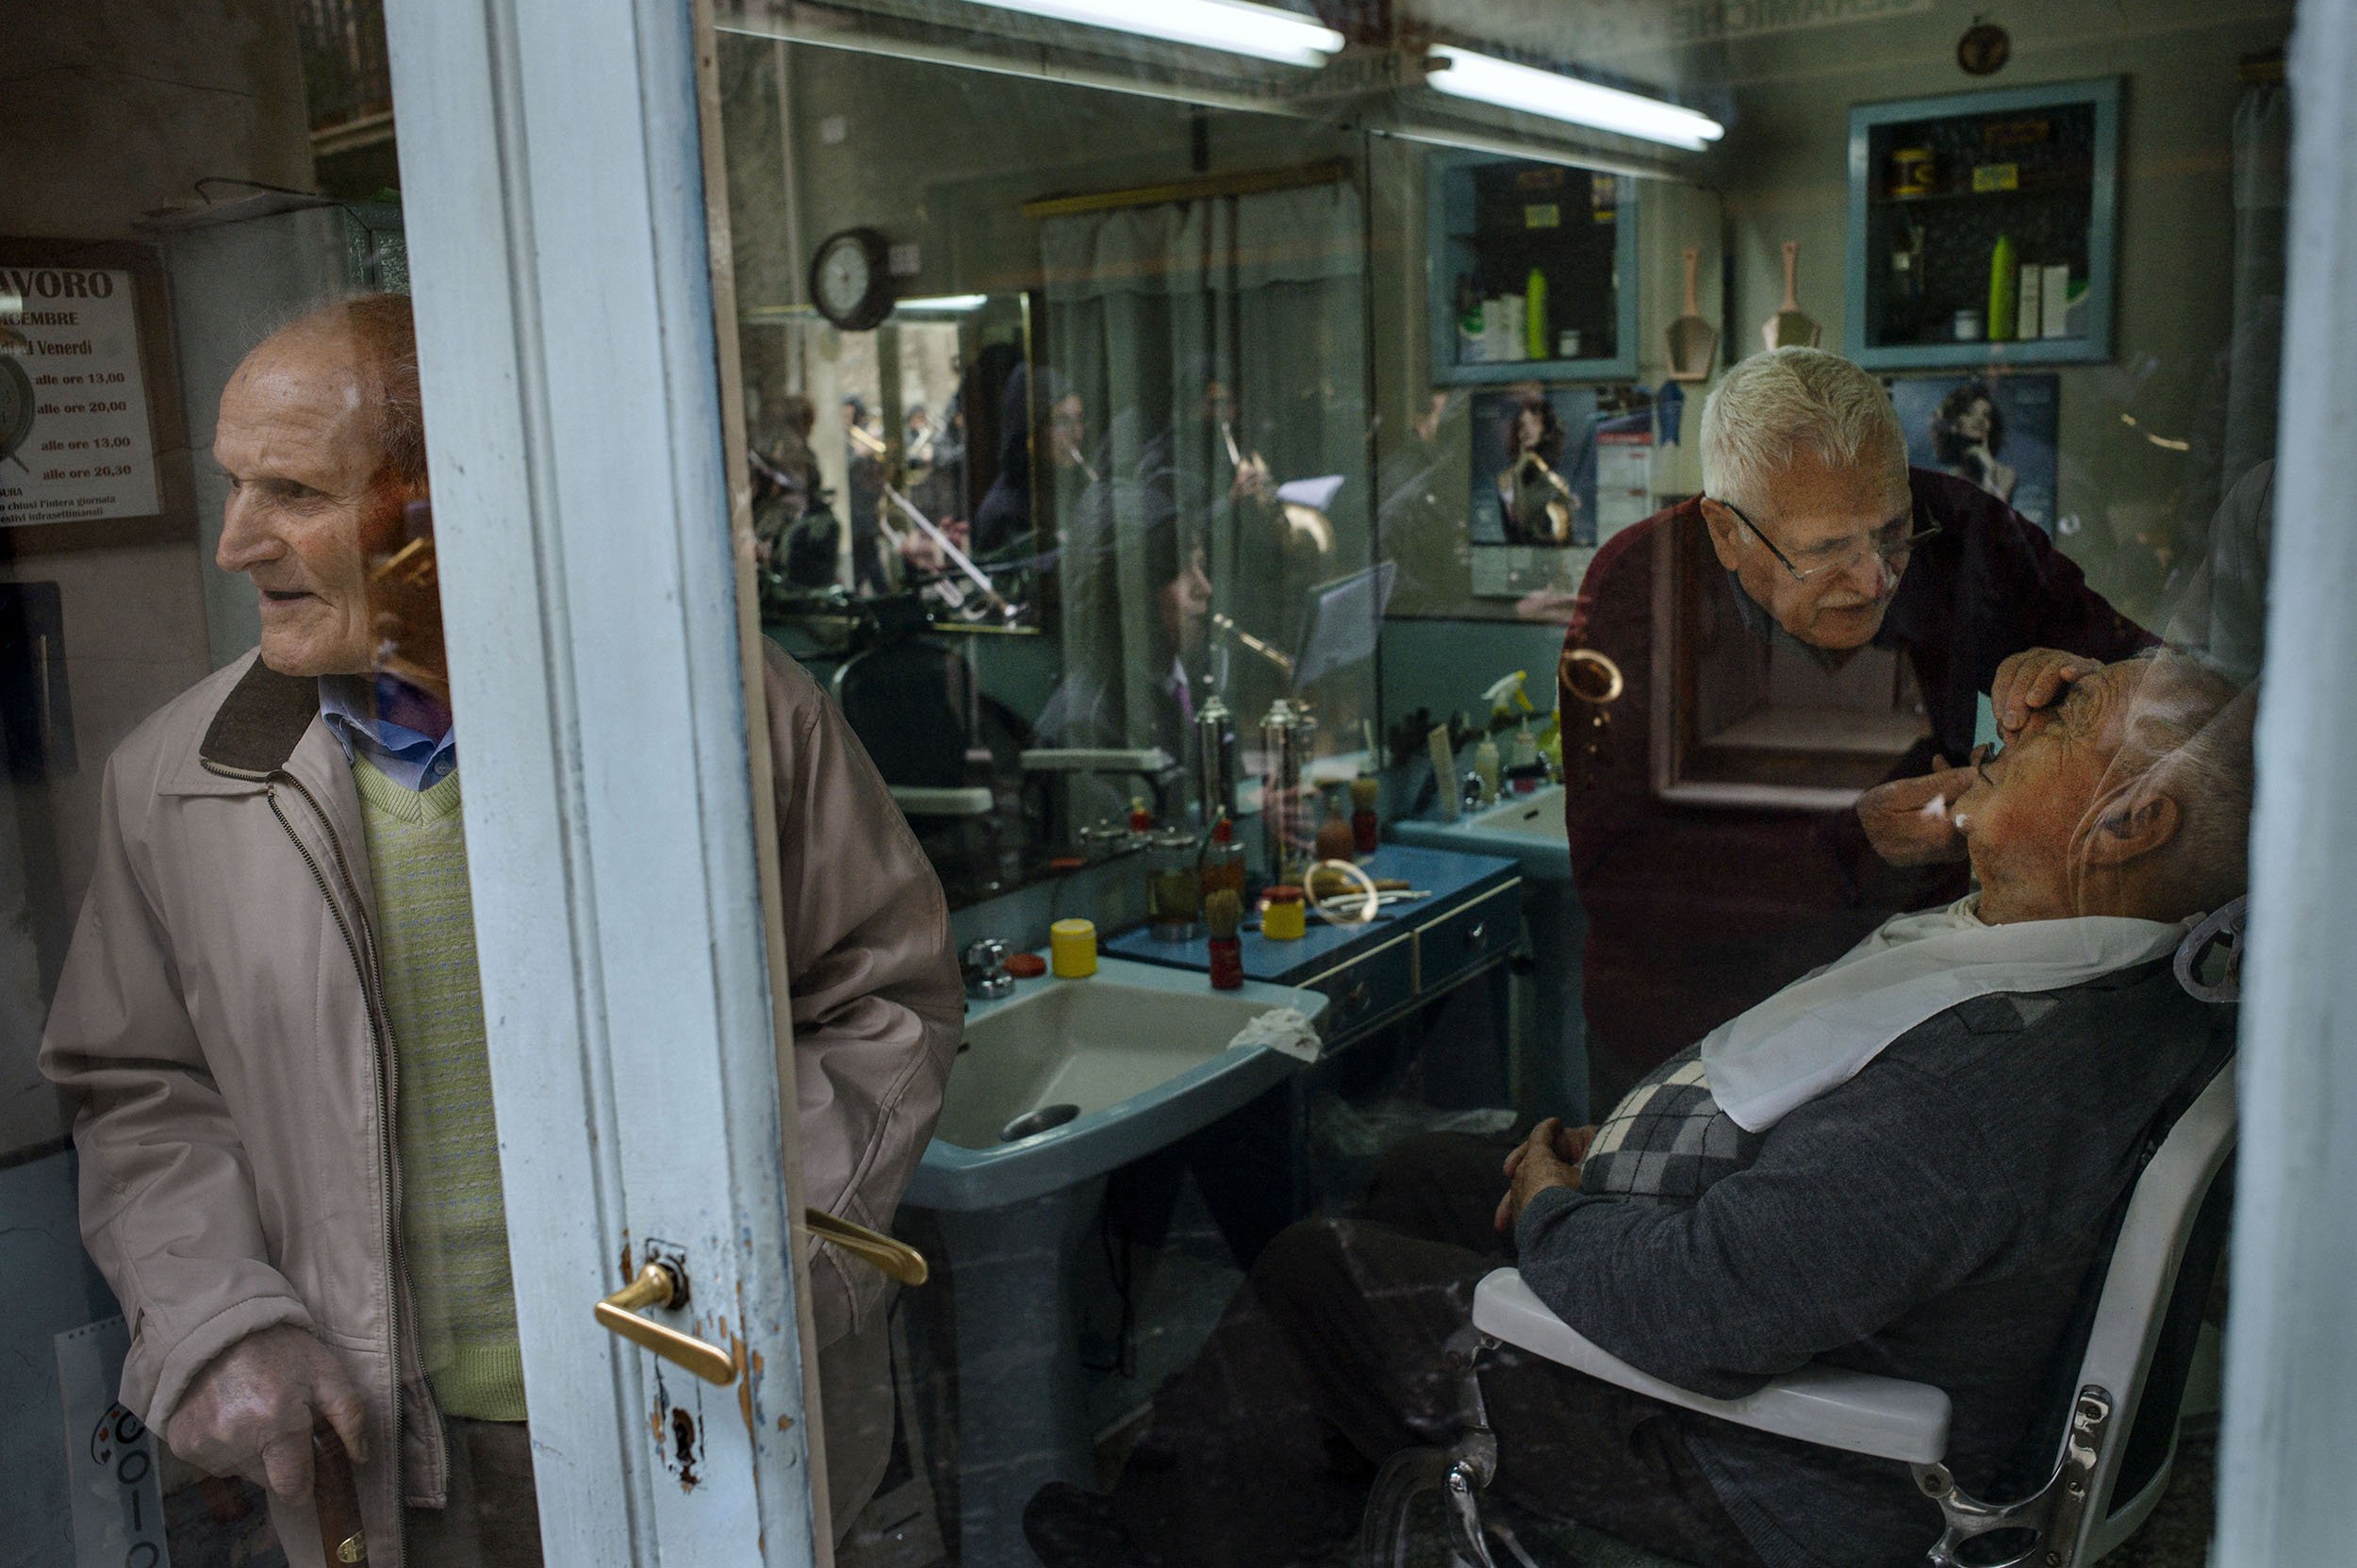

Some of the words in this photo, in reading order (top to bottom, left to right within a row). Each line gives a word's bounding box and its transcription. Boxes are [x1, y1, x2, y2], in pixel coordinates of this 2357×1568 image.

[0, 312, 79, 326] ICEMBRE
[35, 375, 58, 385] alle
[63, 375, 83, 385] ore
[88, 372, 124, 384] 13,00
[37, 404, 60, 414] alle
[64, 404, 86, 414] ore
[89, 402, 126, 412] 20,00
[41, 440, 64, 451] alle
[68, 440, 90, 450] ore
[43, 470, 66, 481] alle
[70, 469, 91, 478] ore
[8, 500, 37, 511] chiusi
[77, 496, 116, 508] giornata
